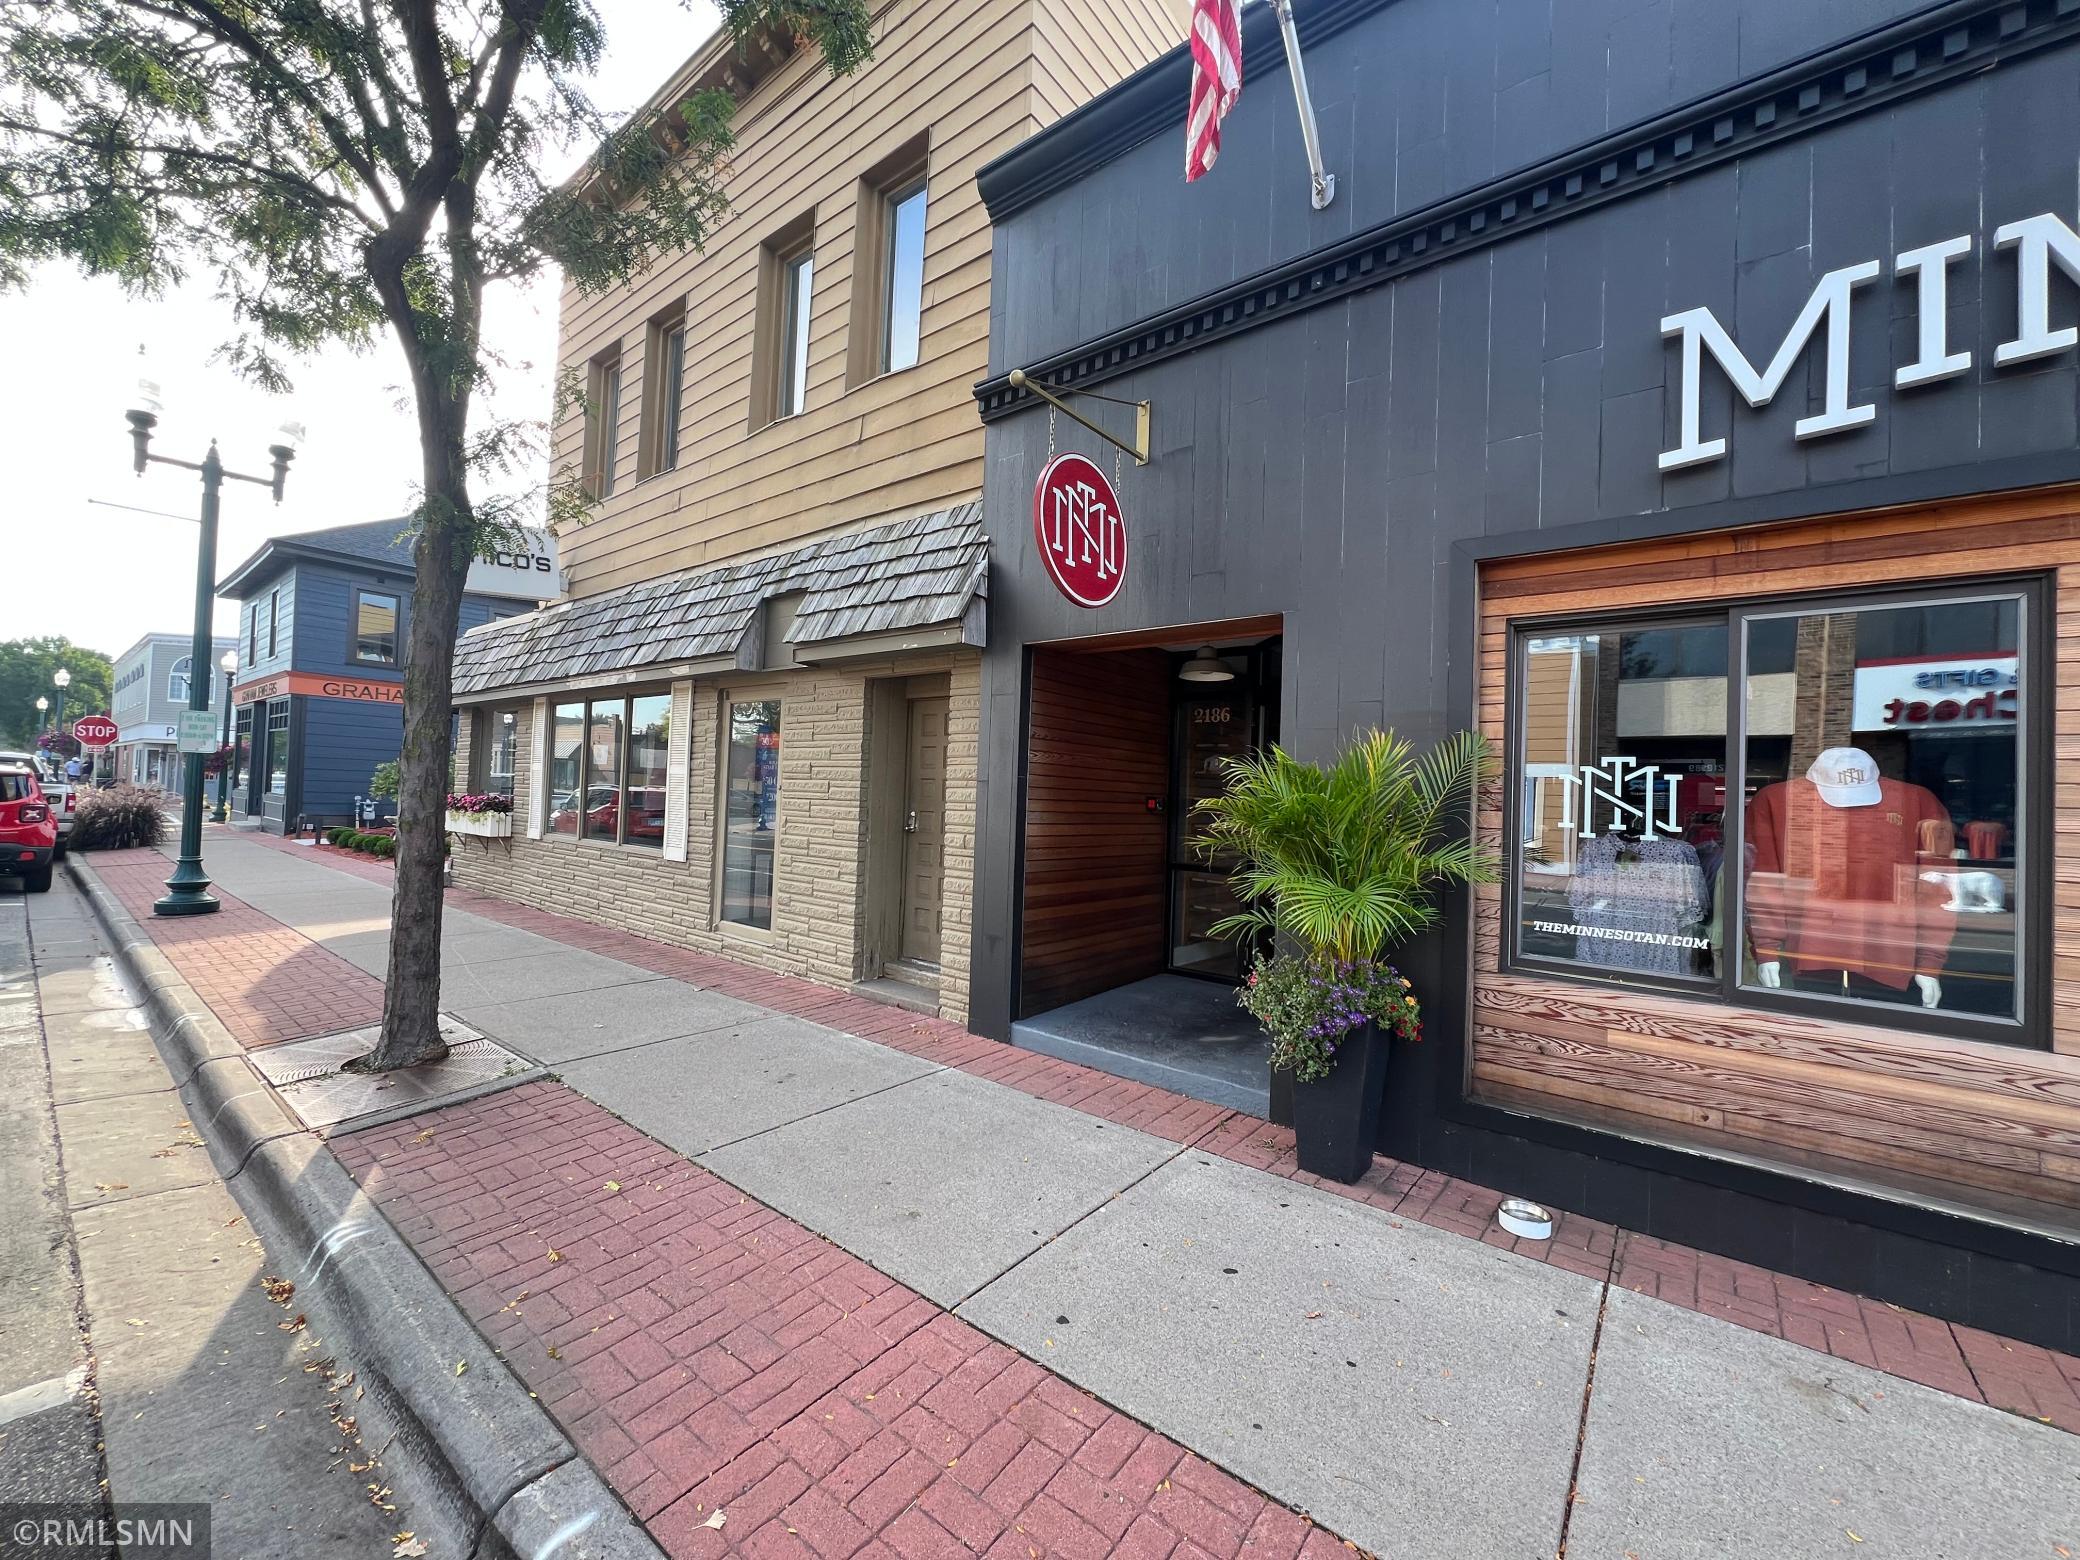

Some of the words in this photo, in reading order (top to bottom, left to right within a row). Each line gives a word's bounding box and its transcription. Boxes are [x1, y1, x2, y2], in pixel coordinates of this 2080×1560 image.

[323, 682, 404, 702] GRAHA
[1194, 707, 1231, 723] 2186
[76, 724, 116, 737] STOP
[1533, 920, 1710, 950] THEMINNESOTAN.COM
